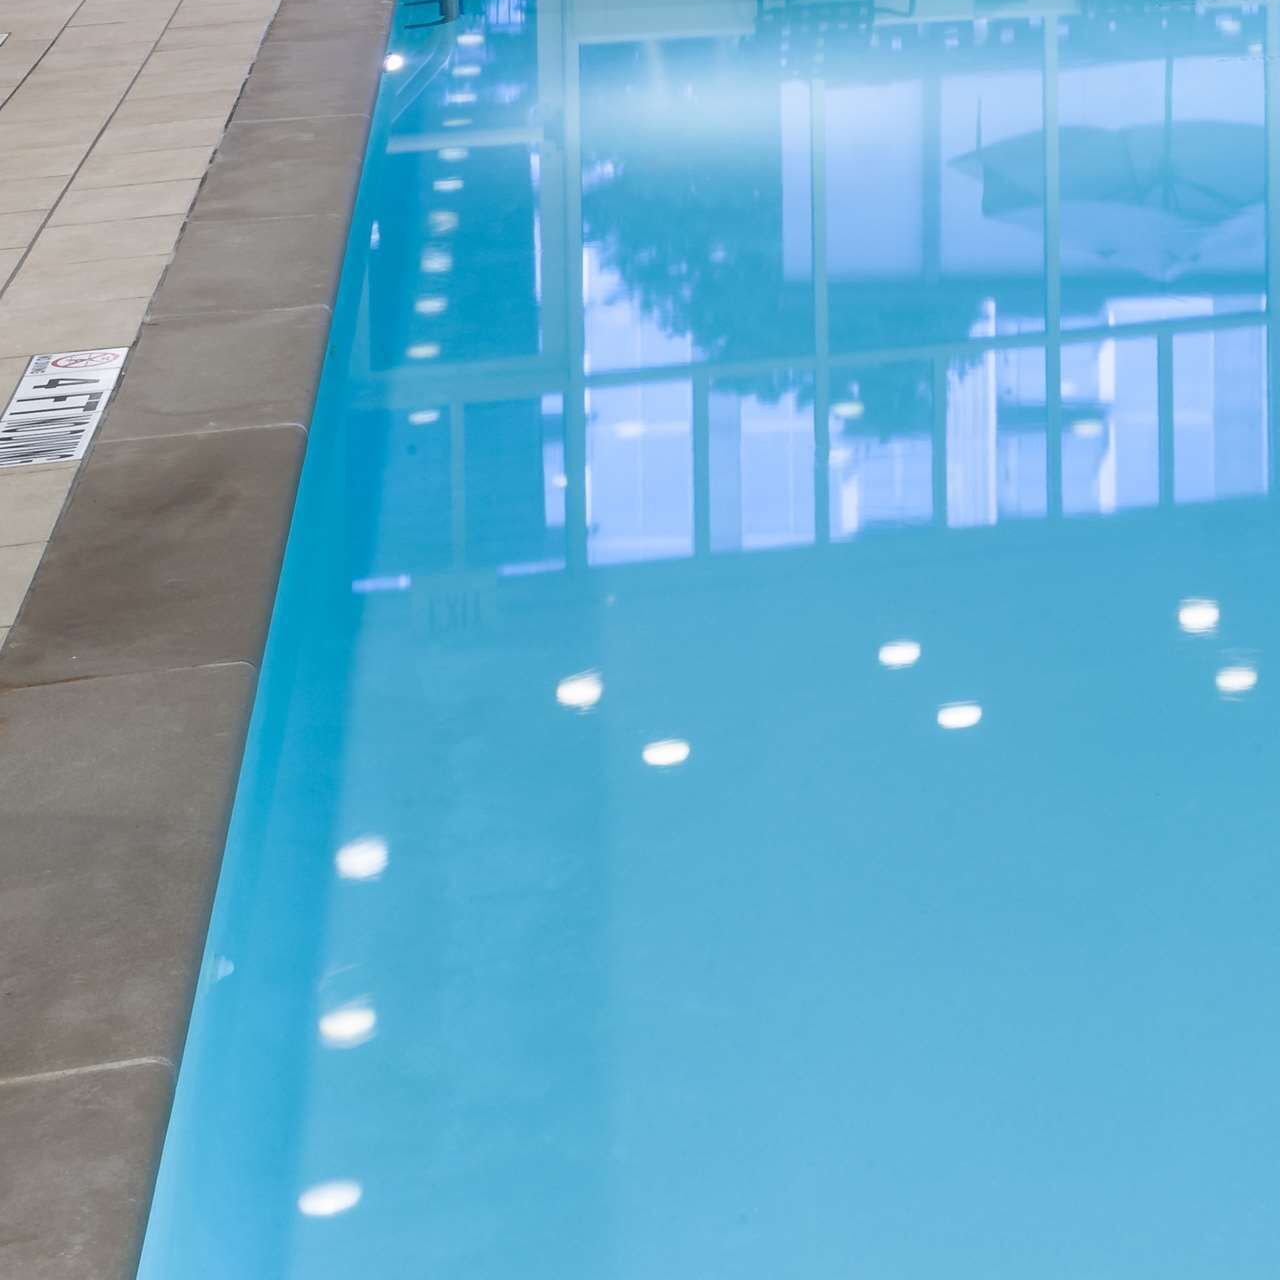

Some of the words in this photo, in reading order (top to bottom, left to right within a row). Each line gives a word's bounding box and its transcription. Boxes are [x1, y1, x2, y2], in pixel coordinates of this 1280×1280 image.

[32, 378, 100, 389] 4
[9, 391, 103, 416] FT
[1, 415, 92, 432] NO
[0, 429, 85, 466] DIVING
